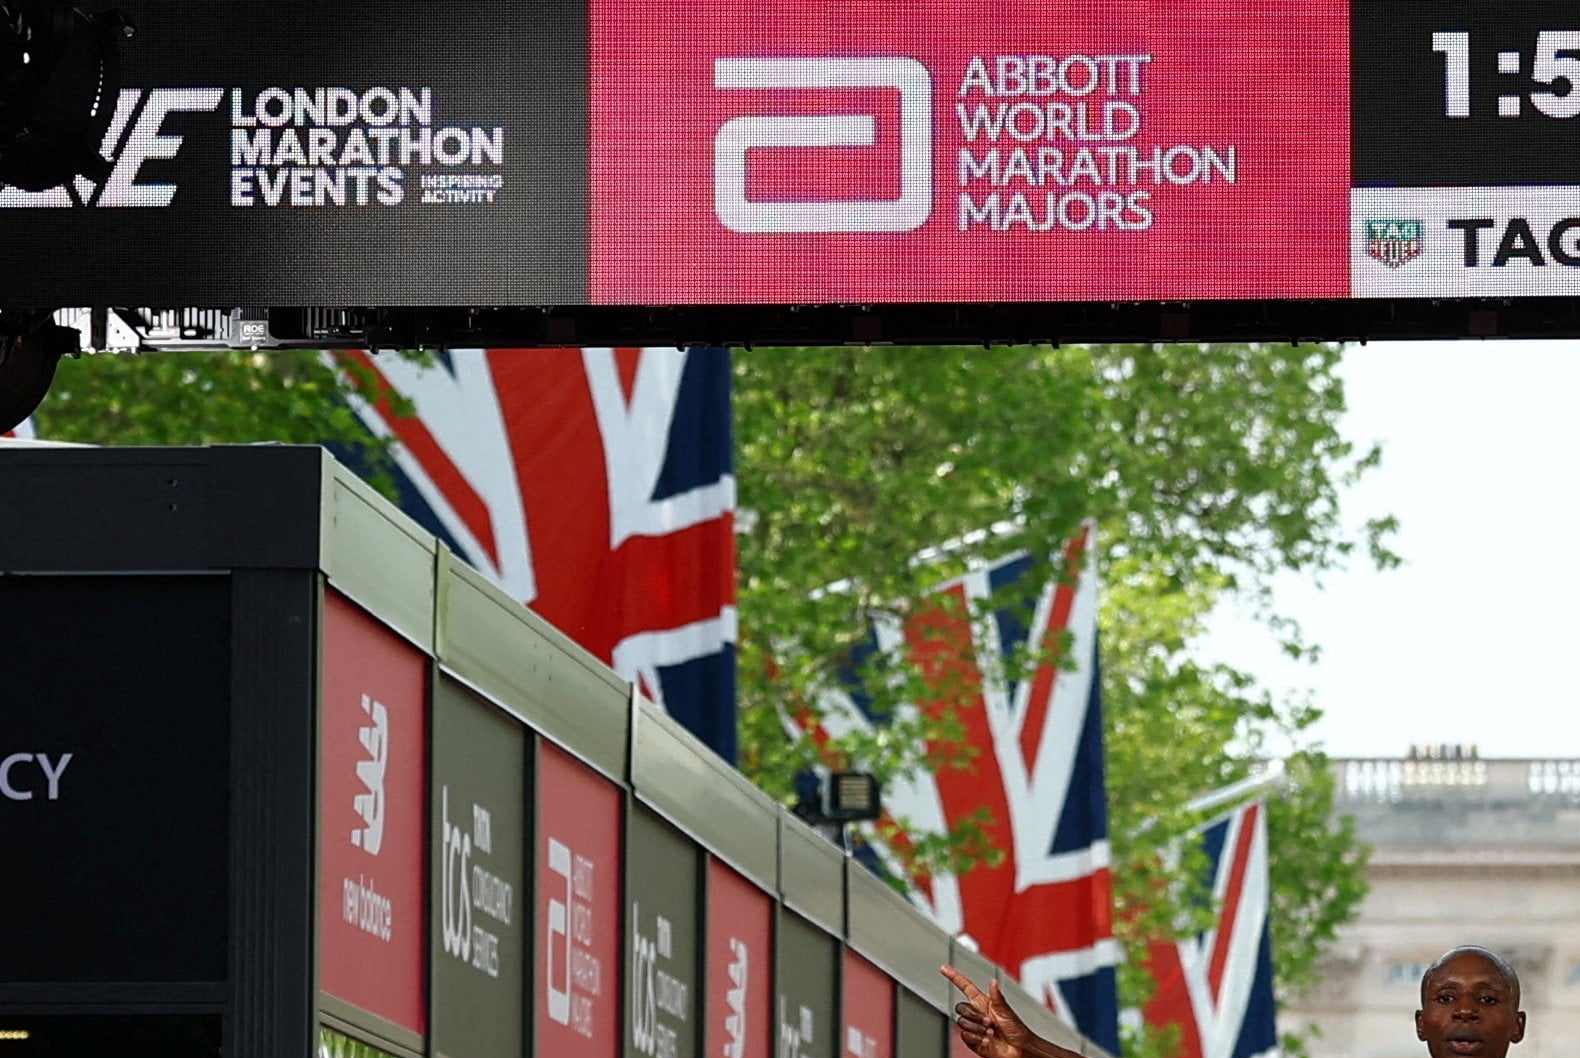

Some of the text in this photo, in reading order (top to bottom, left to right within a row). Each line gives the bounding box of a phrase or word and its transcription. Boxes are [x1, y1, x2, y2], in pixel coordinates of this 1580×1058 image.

[958, 54, 1151, 97] ABBOTT
[231, 87, 431, 127] LONDON
[957, 102, 1140, 143] WORLD
[231, 128, 503, 165] MARATHON
[957, 144, 1237, 185] MARATHON
[231, 167, 405, 207] EVENTS
[421, 189, 496, 203] ACTIVITY
[957, 190, 1154, 231] MAJORS
[0, 753, 73, 801] CY
[442, 785, 472, 963] tcs
